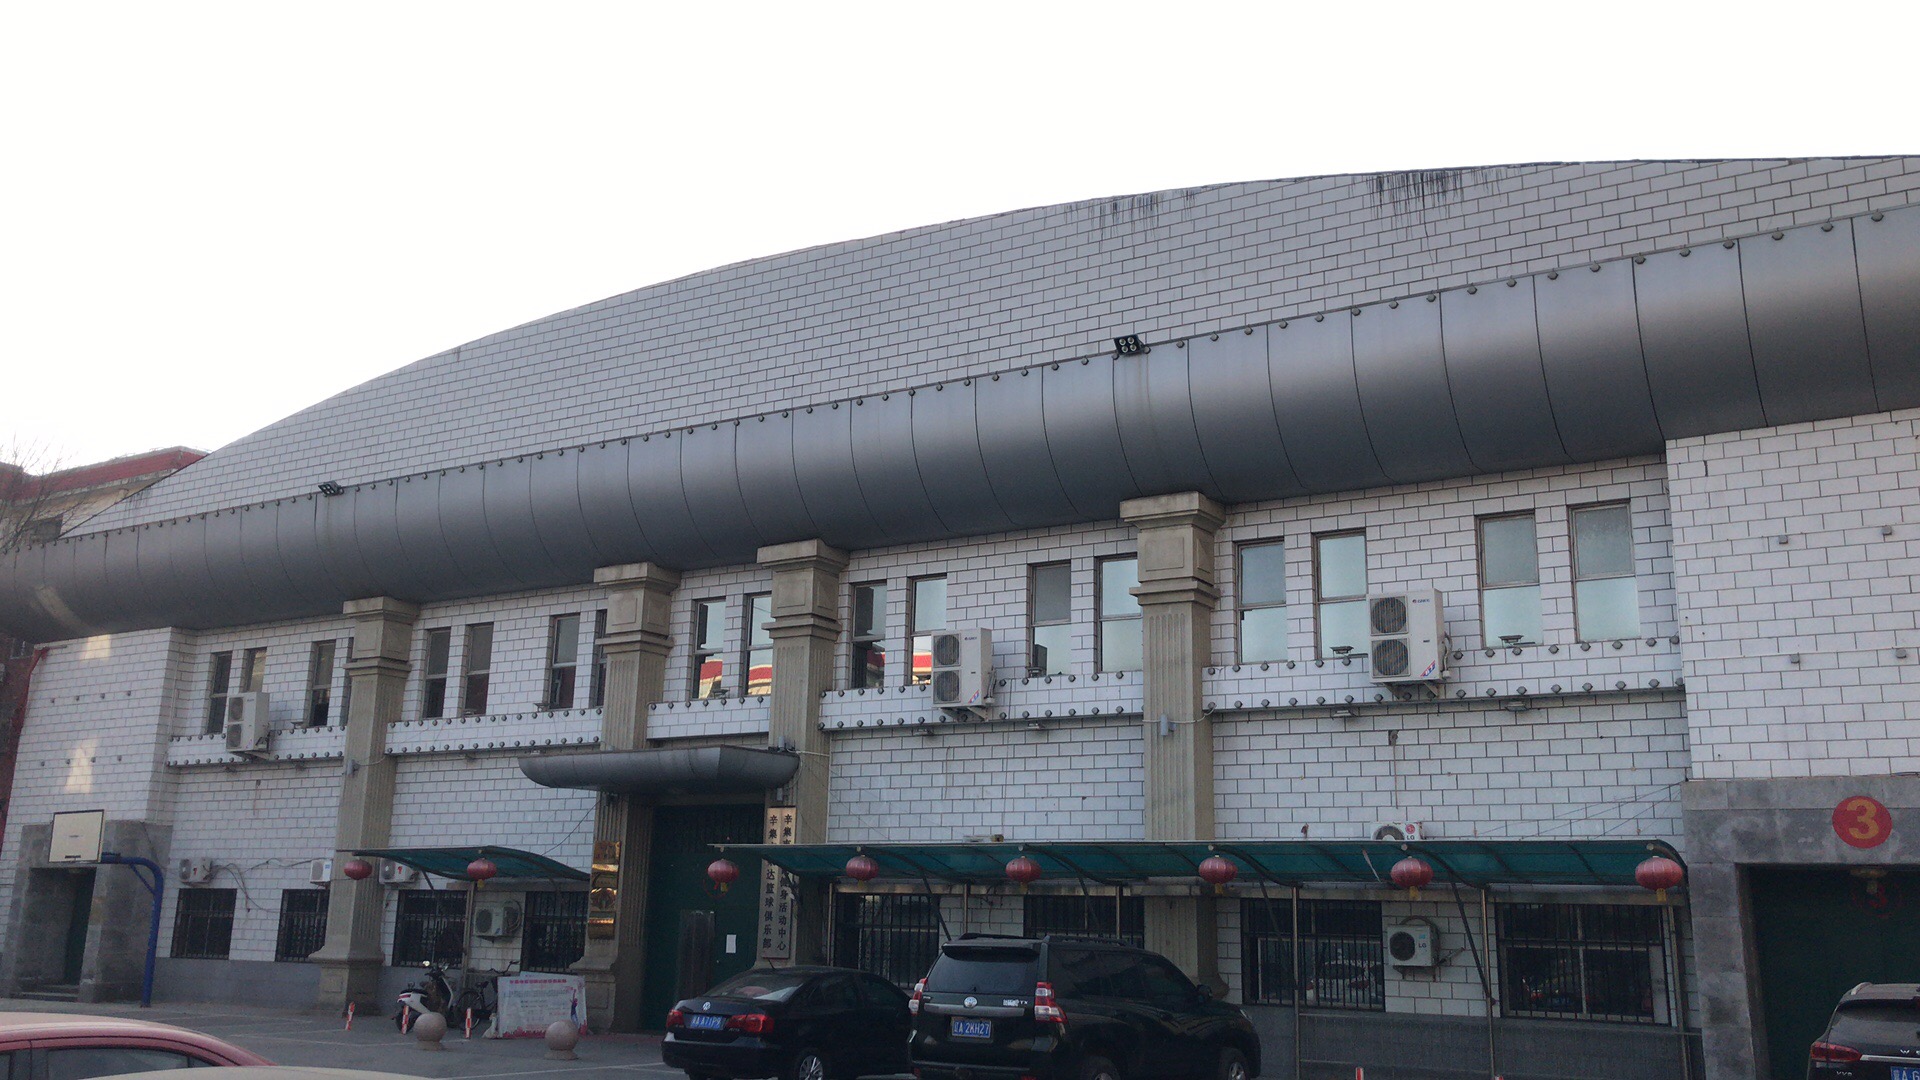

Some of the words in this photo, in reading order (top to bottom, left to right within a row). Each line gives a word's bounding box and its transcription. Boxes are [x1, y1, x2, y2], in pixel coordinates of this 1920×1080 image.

[1846, 799, 1879, 839] 3
[762, 814, 778, 949] 辛集达篮球俱乐部
